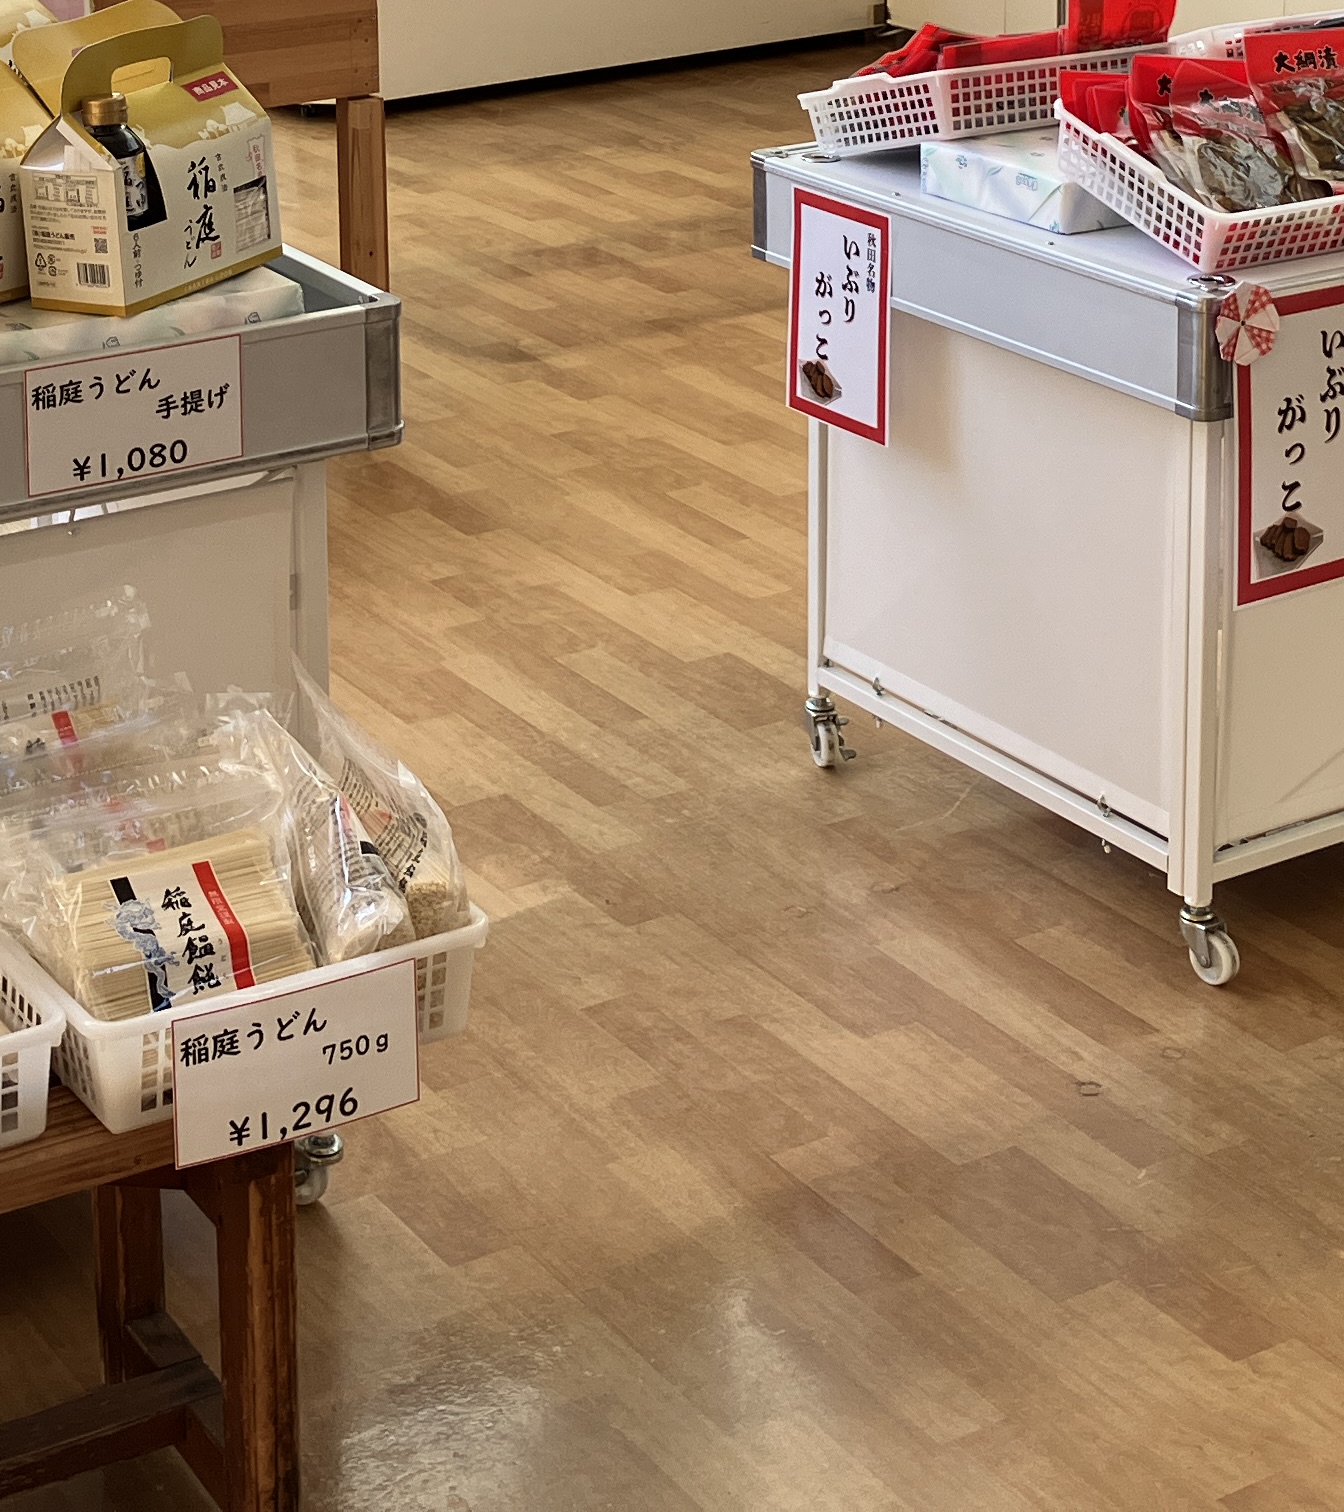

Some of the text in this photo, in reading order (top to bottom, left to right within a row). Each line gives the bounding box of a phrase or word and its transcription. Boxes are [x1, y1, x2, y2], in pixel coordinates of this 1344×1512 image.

[1273, 45, 1340, 74] 大綱漬
[841, 233, 862, 325] いぶり
[866, 232, 878, 294] 秋田名物
[814, 270, 834, 361] がっこ
[31, 368, 162, 410] 稲庭うどん
[155, 382, 231, 420] 手提げ
[71, 438, 189, 482] ¥1,080
[1276, 394, 1308, 513] がっこ
[178, 1006, 330, 1069] 稲庭うどん
[322, 1028, 390, 1067] 750g
[227, 1086, 360, 1148] ¥1,296
